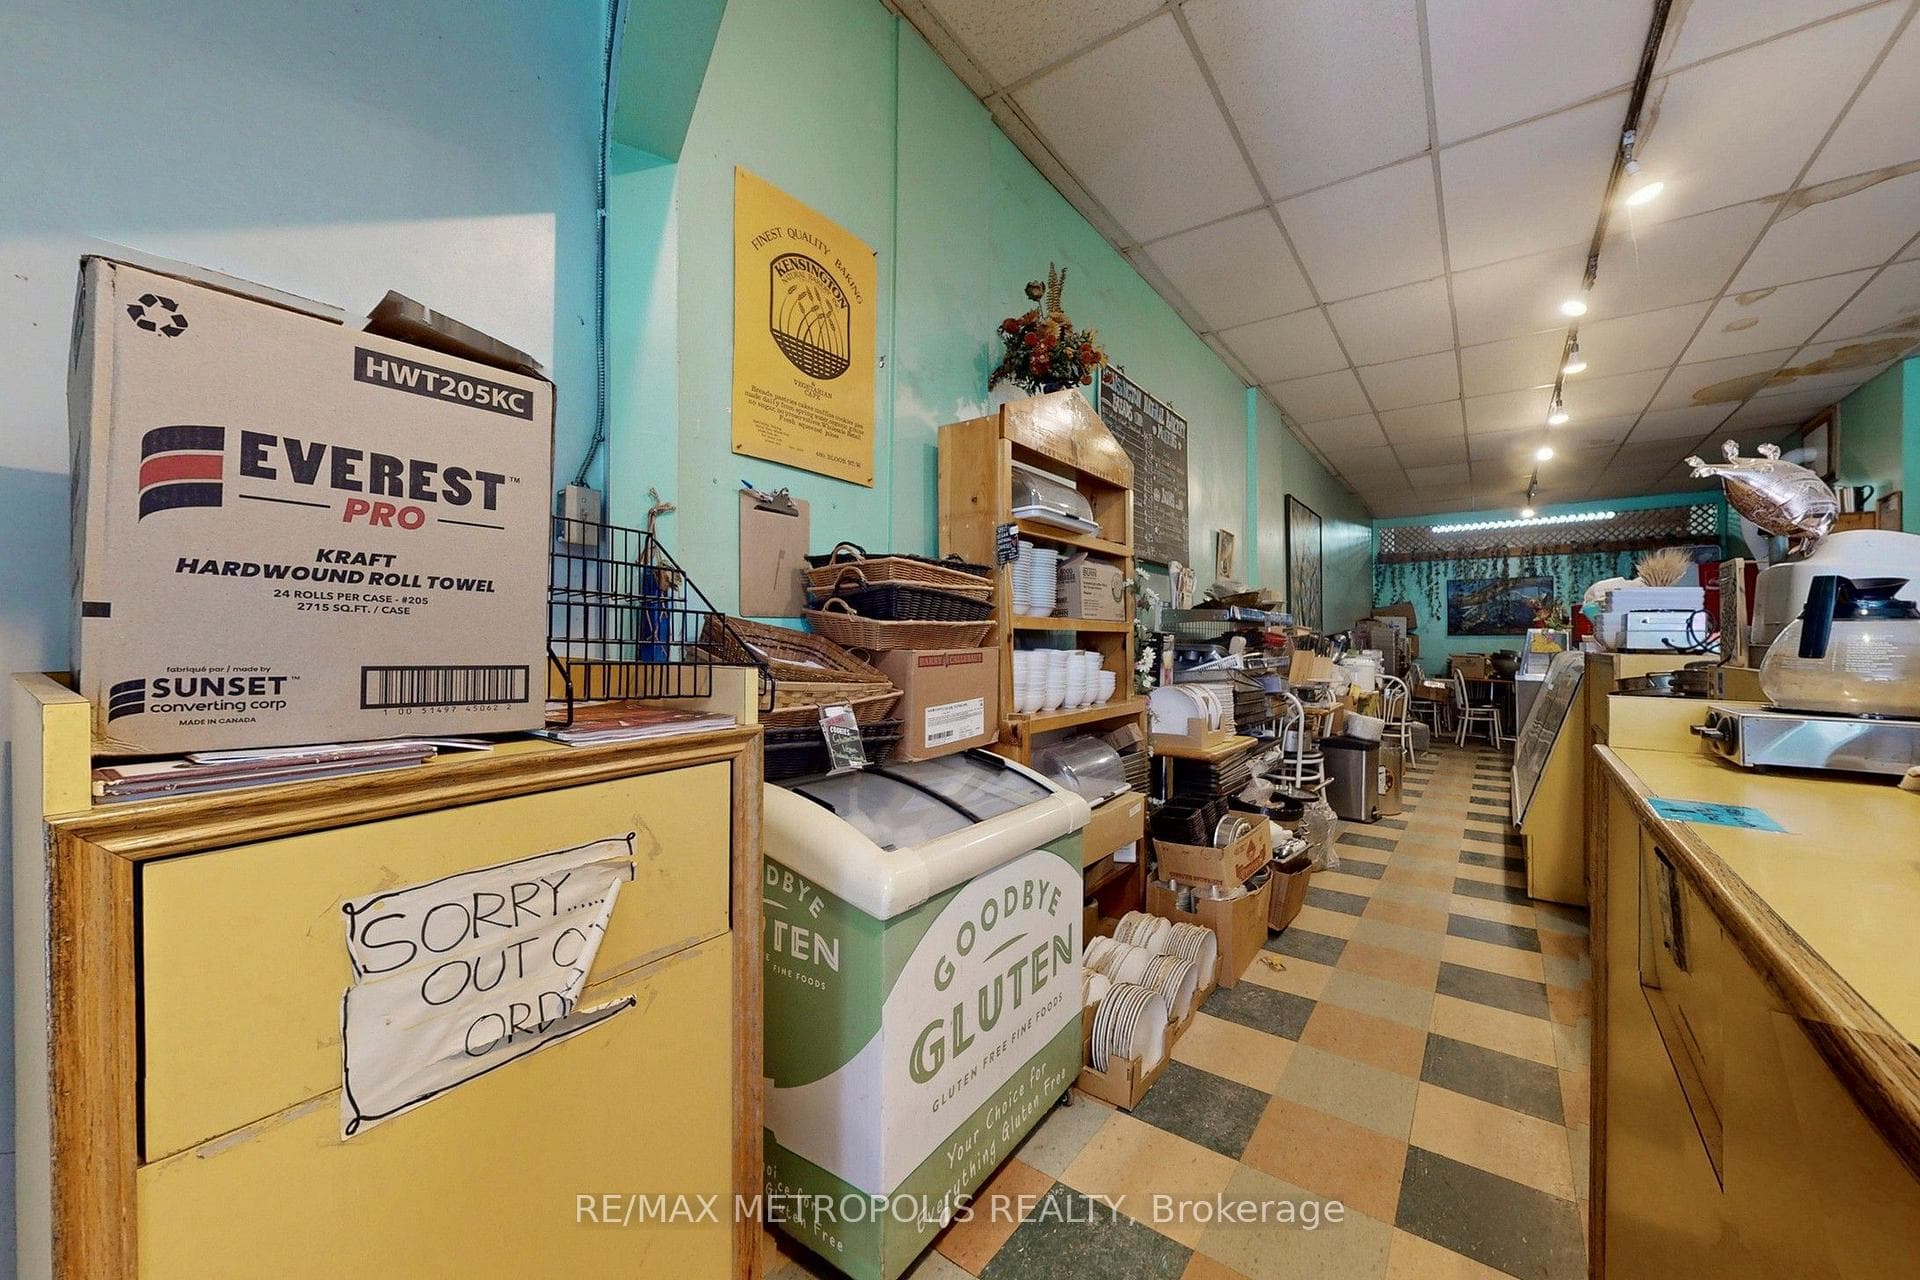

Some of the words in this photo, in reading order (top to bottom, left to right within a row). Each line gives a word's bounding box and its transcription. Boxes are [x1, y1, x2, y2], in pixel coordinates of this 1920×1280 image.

[751, 227, 783, 251] FINEST
[787, 227, 831, 256] QUALITY
[834, 258, 864, 305] BAKING
[774, 257, 849, 311] KENSINGTON
[365, 356, 525, 414] HWT205KC
[239, 429, 506, 511] EVEREST
[342, 497, 426, 531] PRO
[175, 557, 364, 584] HARDWOUND
[368, 571, 421, 588] ROLL
[426, 575, 495, 593] TOWEL
[315, 548, 397, 568] KRAFT
[273, 589, 290, 598] 24
[294, 589, 334, 600] ROLLS
[337, 592, 360, 602] PER
[363, 593, 393, 603] CASE
[401, 595, 429, 606] #205
[297, 602, 329, 612] 2715
[333, 603, 371, 614] SQ.FT.
[381, 605, 410, 615] CASE
[151, 676, 287, 698] SUNSET
[166, 666, 207, 674] fabriqué
[150, 699, 246, 713] converting
[250, 699, 287, 711] corp
[179, 718, 205, 726] MADE
[422, 705, 457, 714] 51497
[465, 704, 498, 712] 45062
[766, 863, 825, 919] DBYE
[773, 919, 839, 973] TEN
[934, 879, 1061, 992] GOODBYE
[421, 937, 539, 1006] OUT
[772, 964, 792, 978] FINE
[796, 973, 826, 991] FOODS
[908, 922, 1073, 1085] GLUTEN
[932, 1066, 978, 1113] GLUTEN
[982, 1040, 1008, 1070] FREE
[1011, 1018, 1032, 1044] FINE
[1035, 992, 1063, 1023] FOODS
[947, 1129, 979, 1169] Your
[986, 1084, 1024, 1130] Choice
[1030, 1063, 1046, 1089] for
[917, 1139, 996, 1233] Everything
[1002, 1095, 1039, 1143] Gluten
[1044, 1068, 1066, 1096] Free
[813, 1220, 843, 1252] Free
